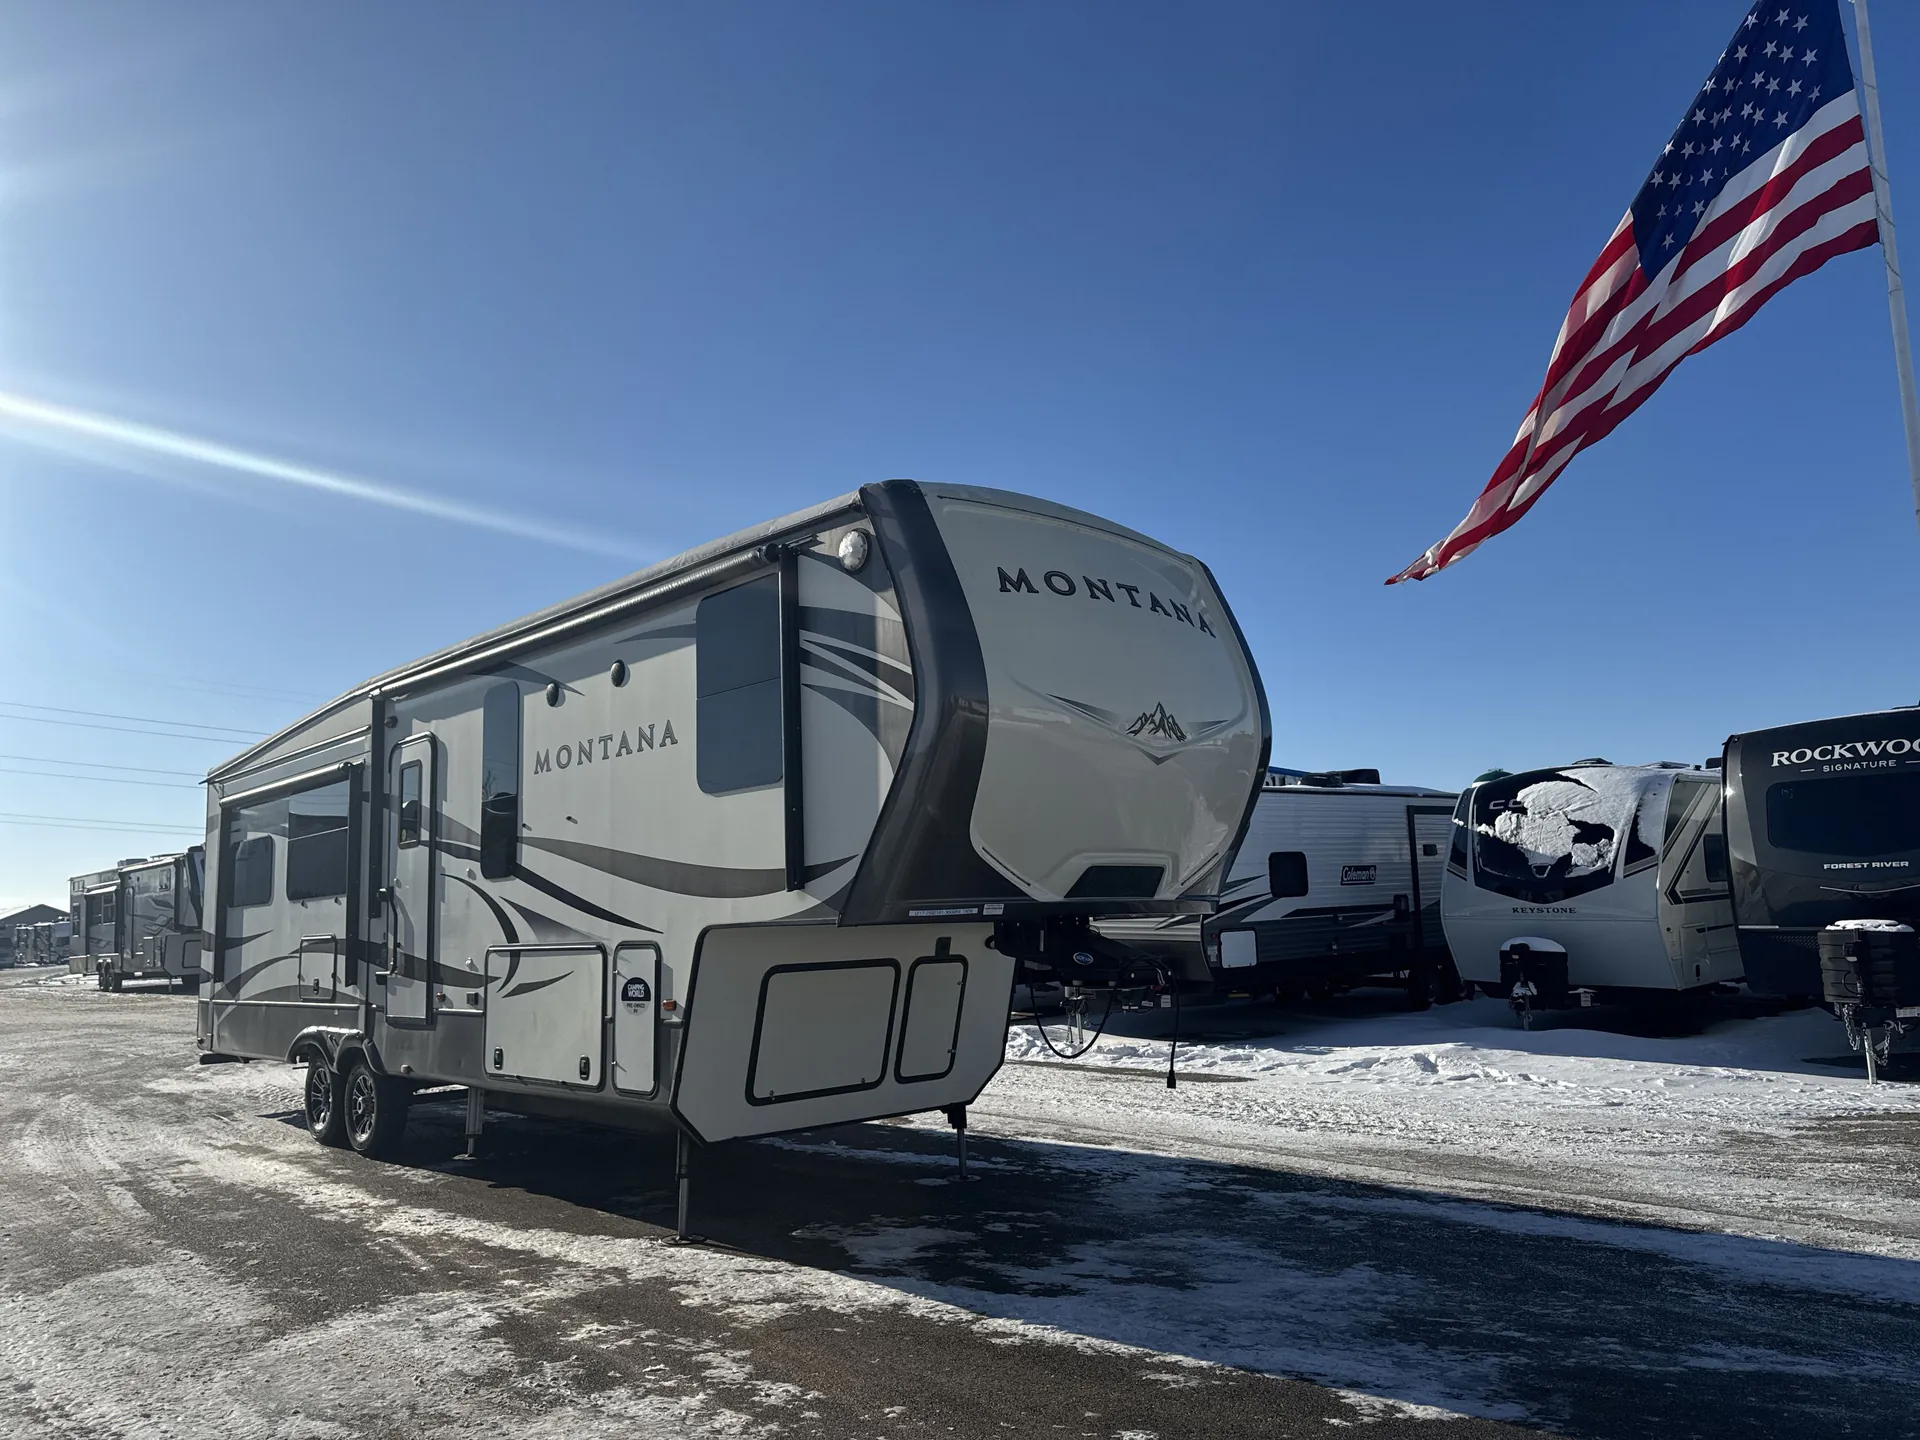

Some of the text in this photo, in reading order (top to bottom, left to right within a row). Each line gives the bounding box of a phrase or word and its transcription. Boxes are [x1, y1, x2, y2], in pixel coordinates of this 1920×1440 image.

[997, 566, 1217, 639] MONTANA
[533, 719, 679, 775] MONTANA
[1822, 759, 1897, 772] SIGNATURE
[1823, 862, 1870, 870] FOREST
[1342, 866, 1370, 881] Coleman
[627, 990, 645, 998] WORLD
